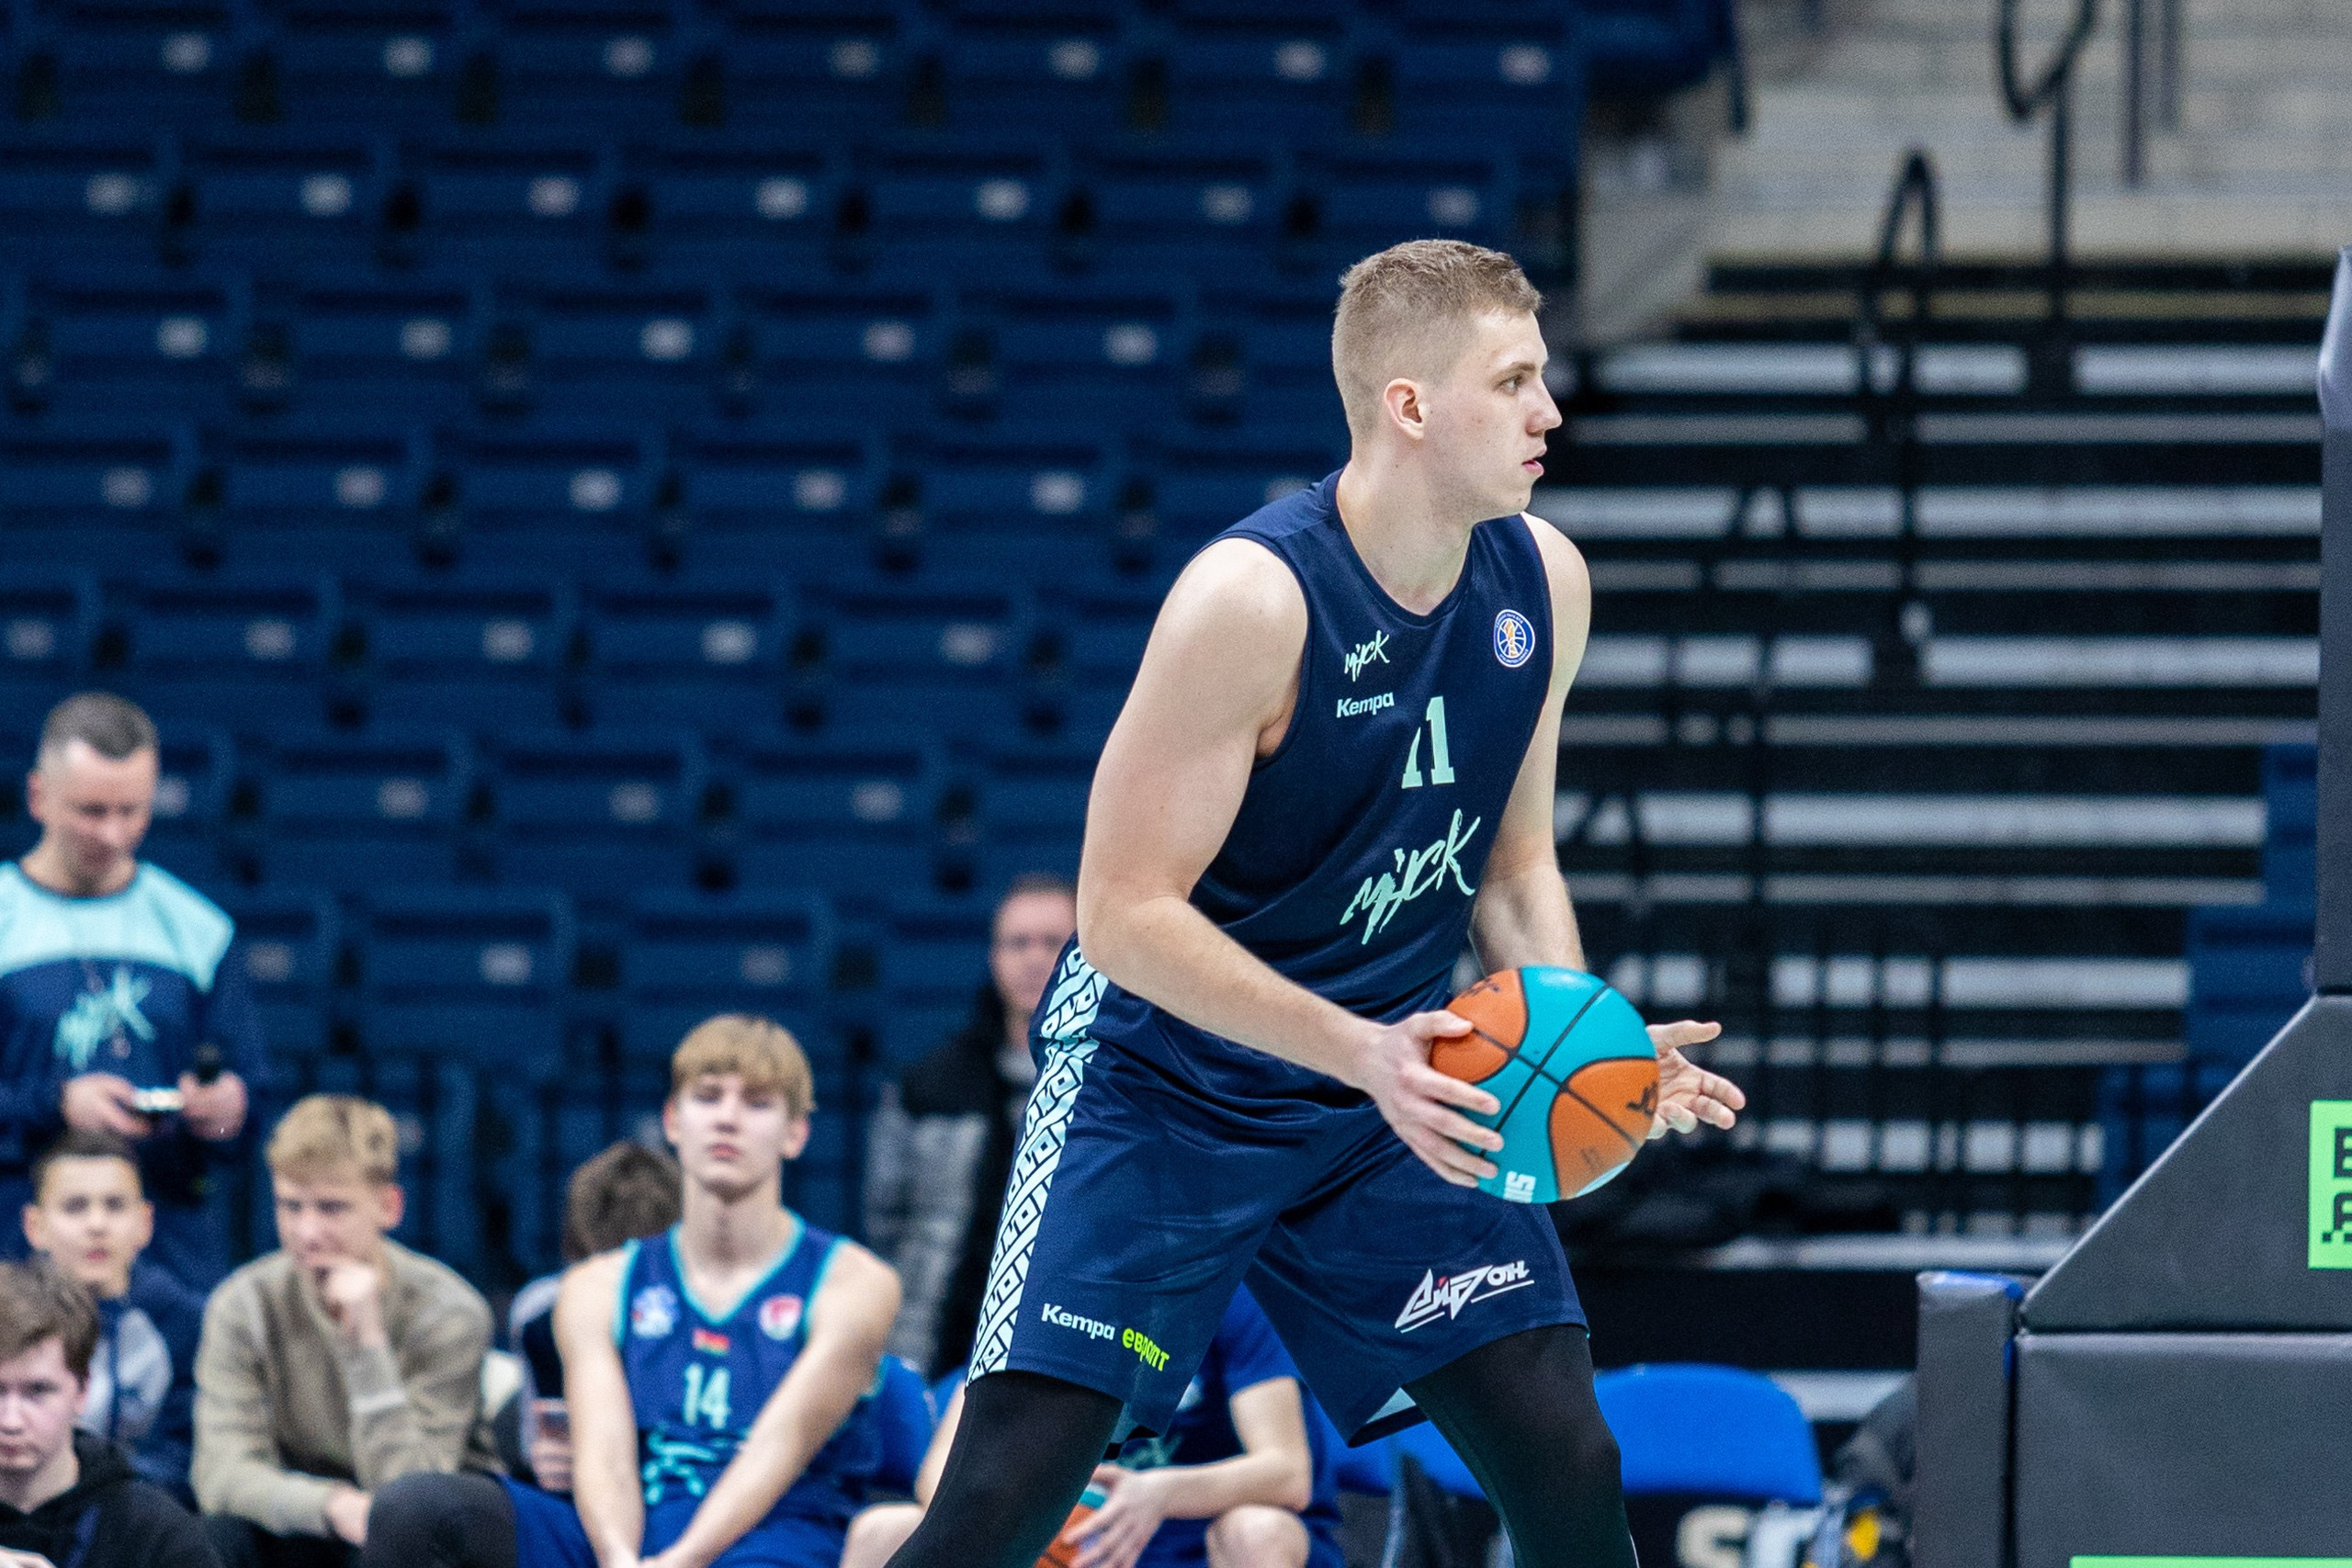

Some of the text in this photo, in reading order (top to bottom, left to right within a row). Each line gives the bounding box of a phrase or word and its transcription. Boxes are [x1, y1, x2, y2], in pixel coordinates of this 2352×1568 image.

[1337, 692, 1395, 718] Kempa
[1041, 1303, 1115, 1340] Kempa
[683, 1363, 731, 1429] 14
